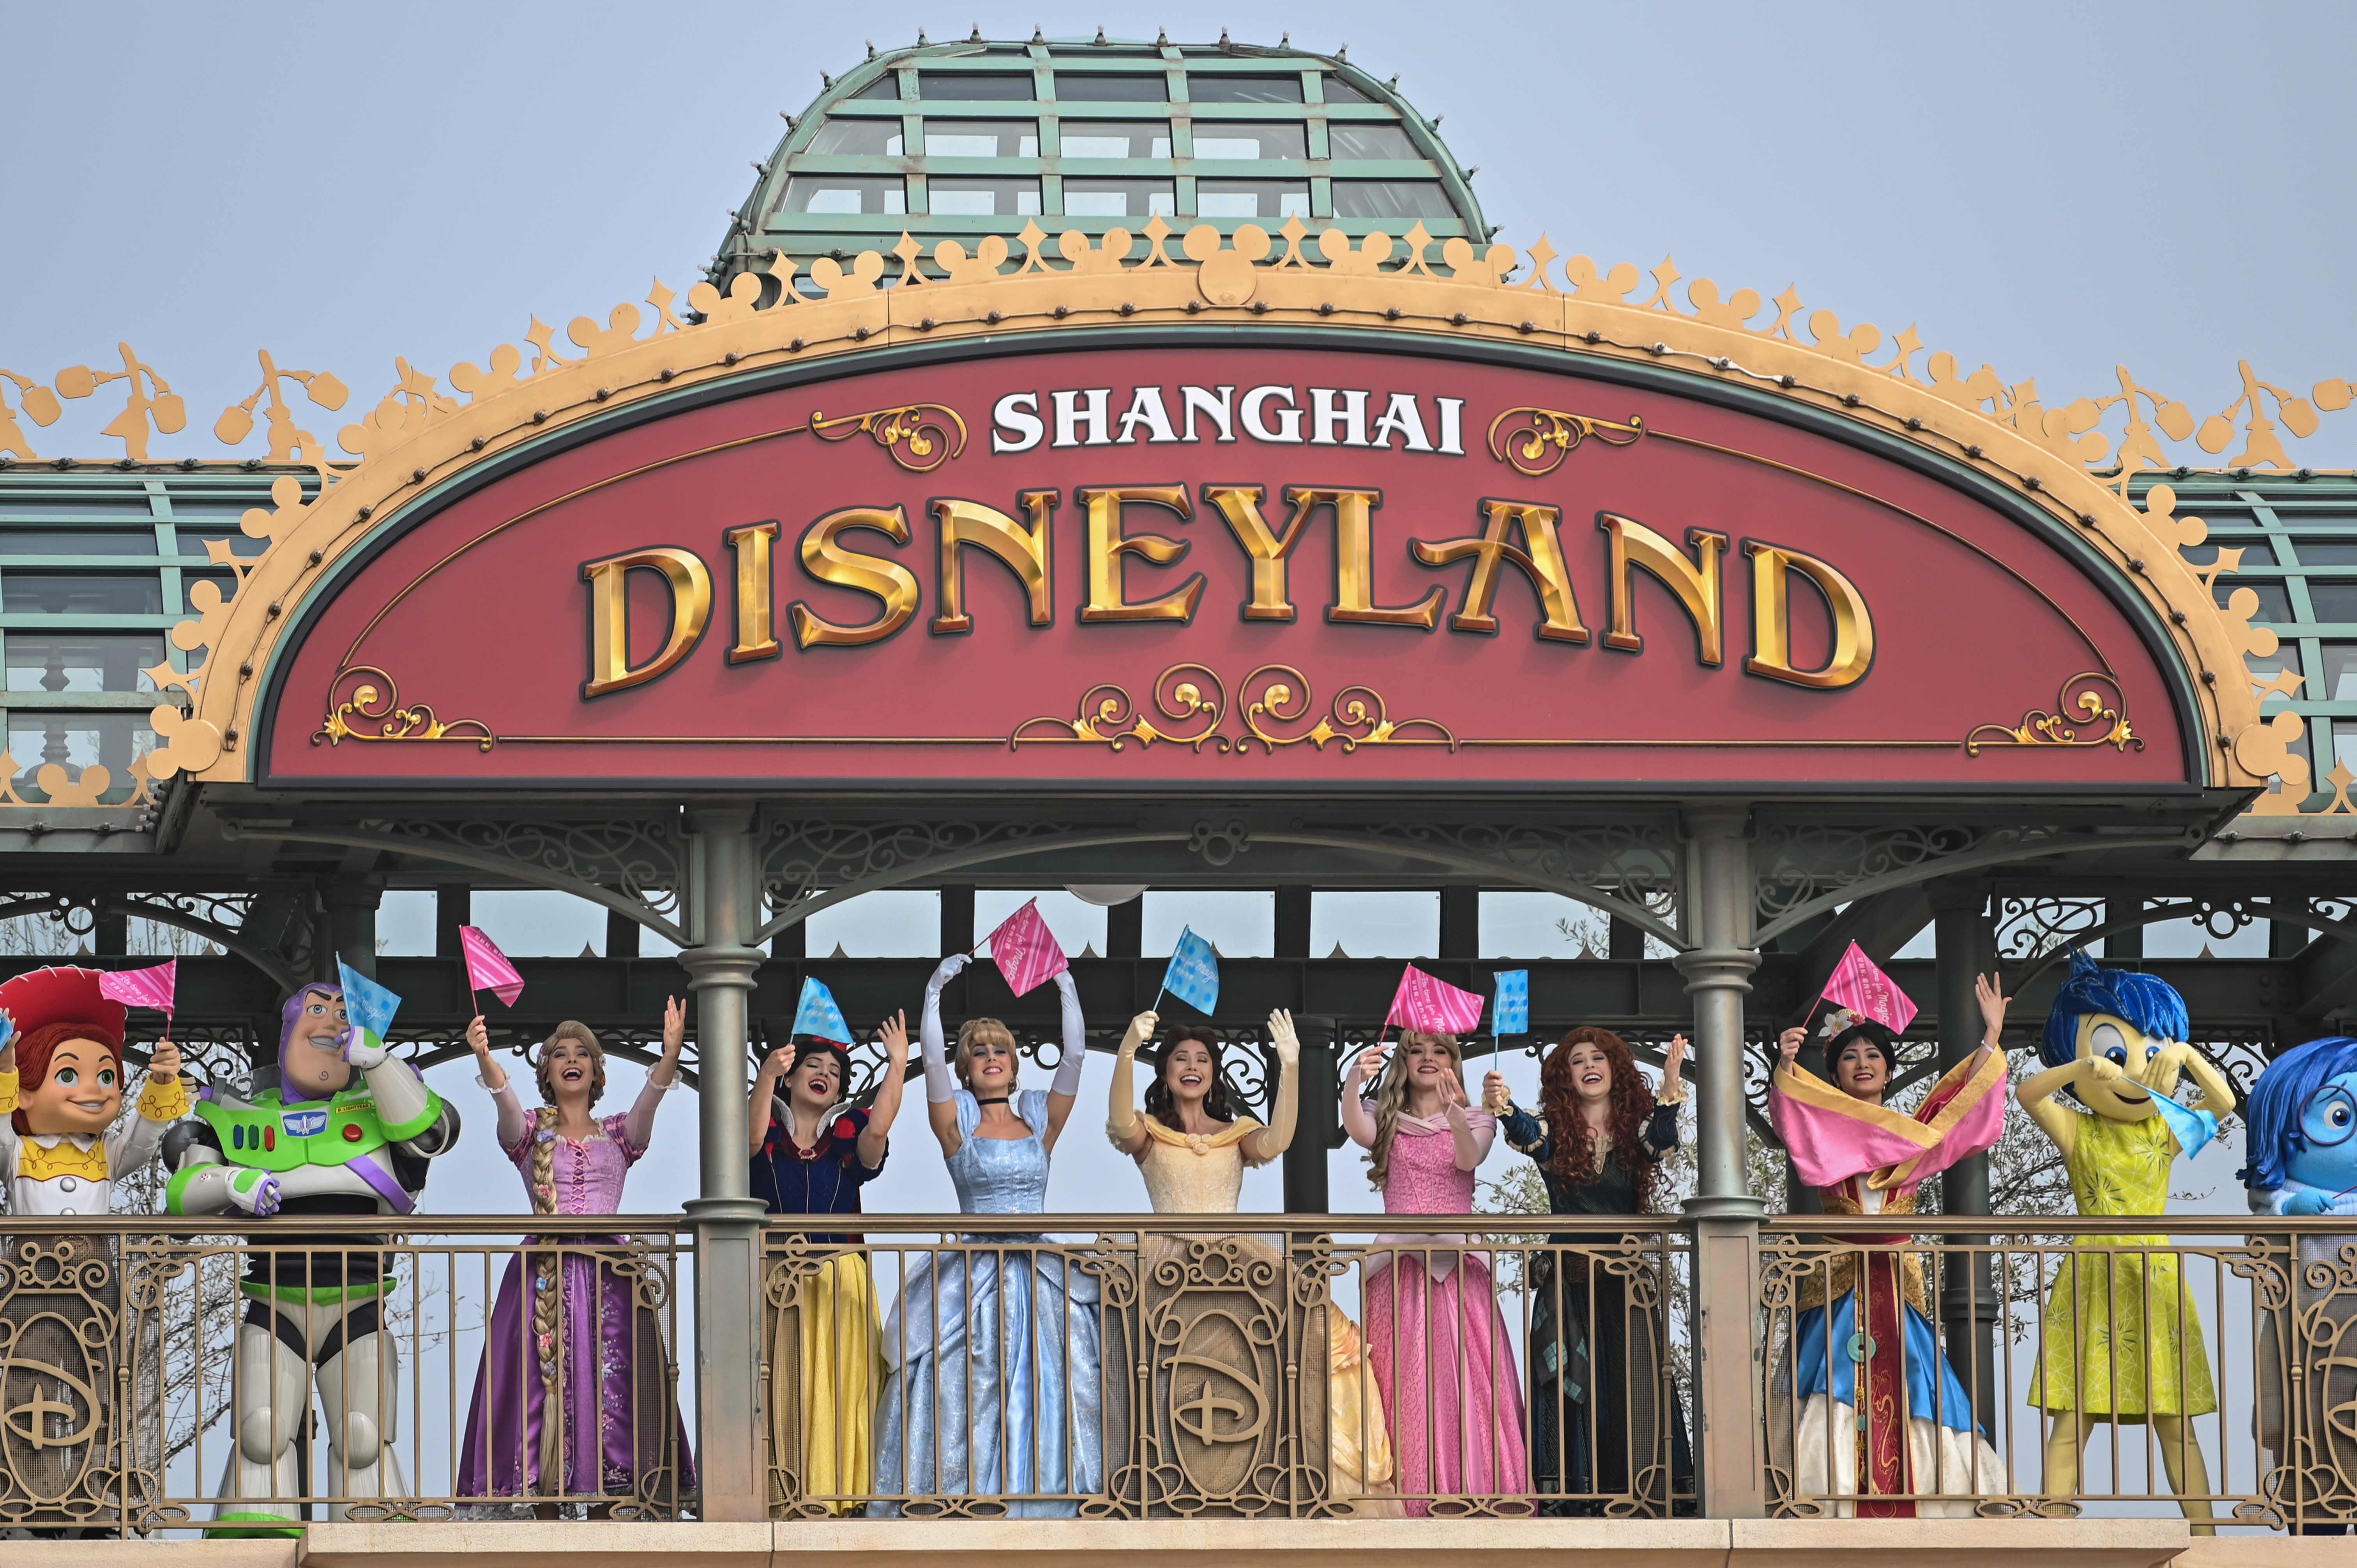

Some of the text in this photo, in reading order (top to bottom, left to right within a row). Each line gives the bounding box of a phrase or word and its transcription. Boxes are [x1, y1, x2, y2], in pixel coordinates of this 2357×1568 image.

[991, 385, 1465, 455] SHANGHAI
[582, 482, 1875, 700] DISNEYLAND
[1016, 933, 1026, 946] for
[1005, 947, 1026, 981] Magic
[361, 996, 387, 1021] Magic
[1424, 1004, 1436, 1015] for
[1873, 991, 1892, 1022] Magic
